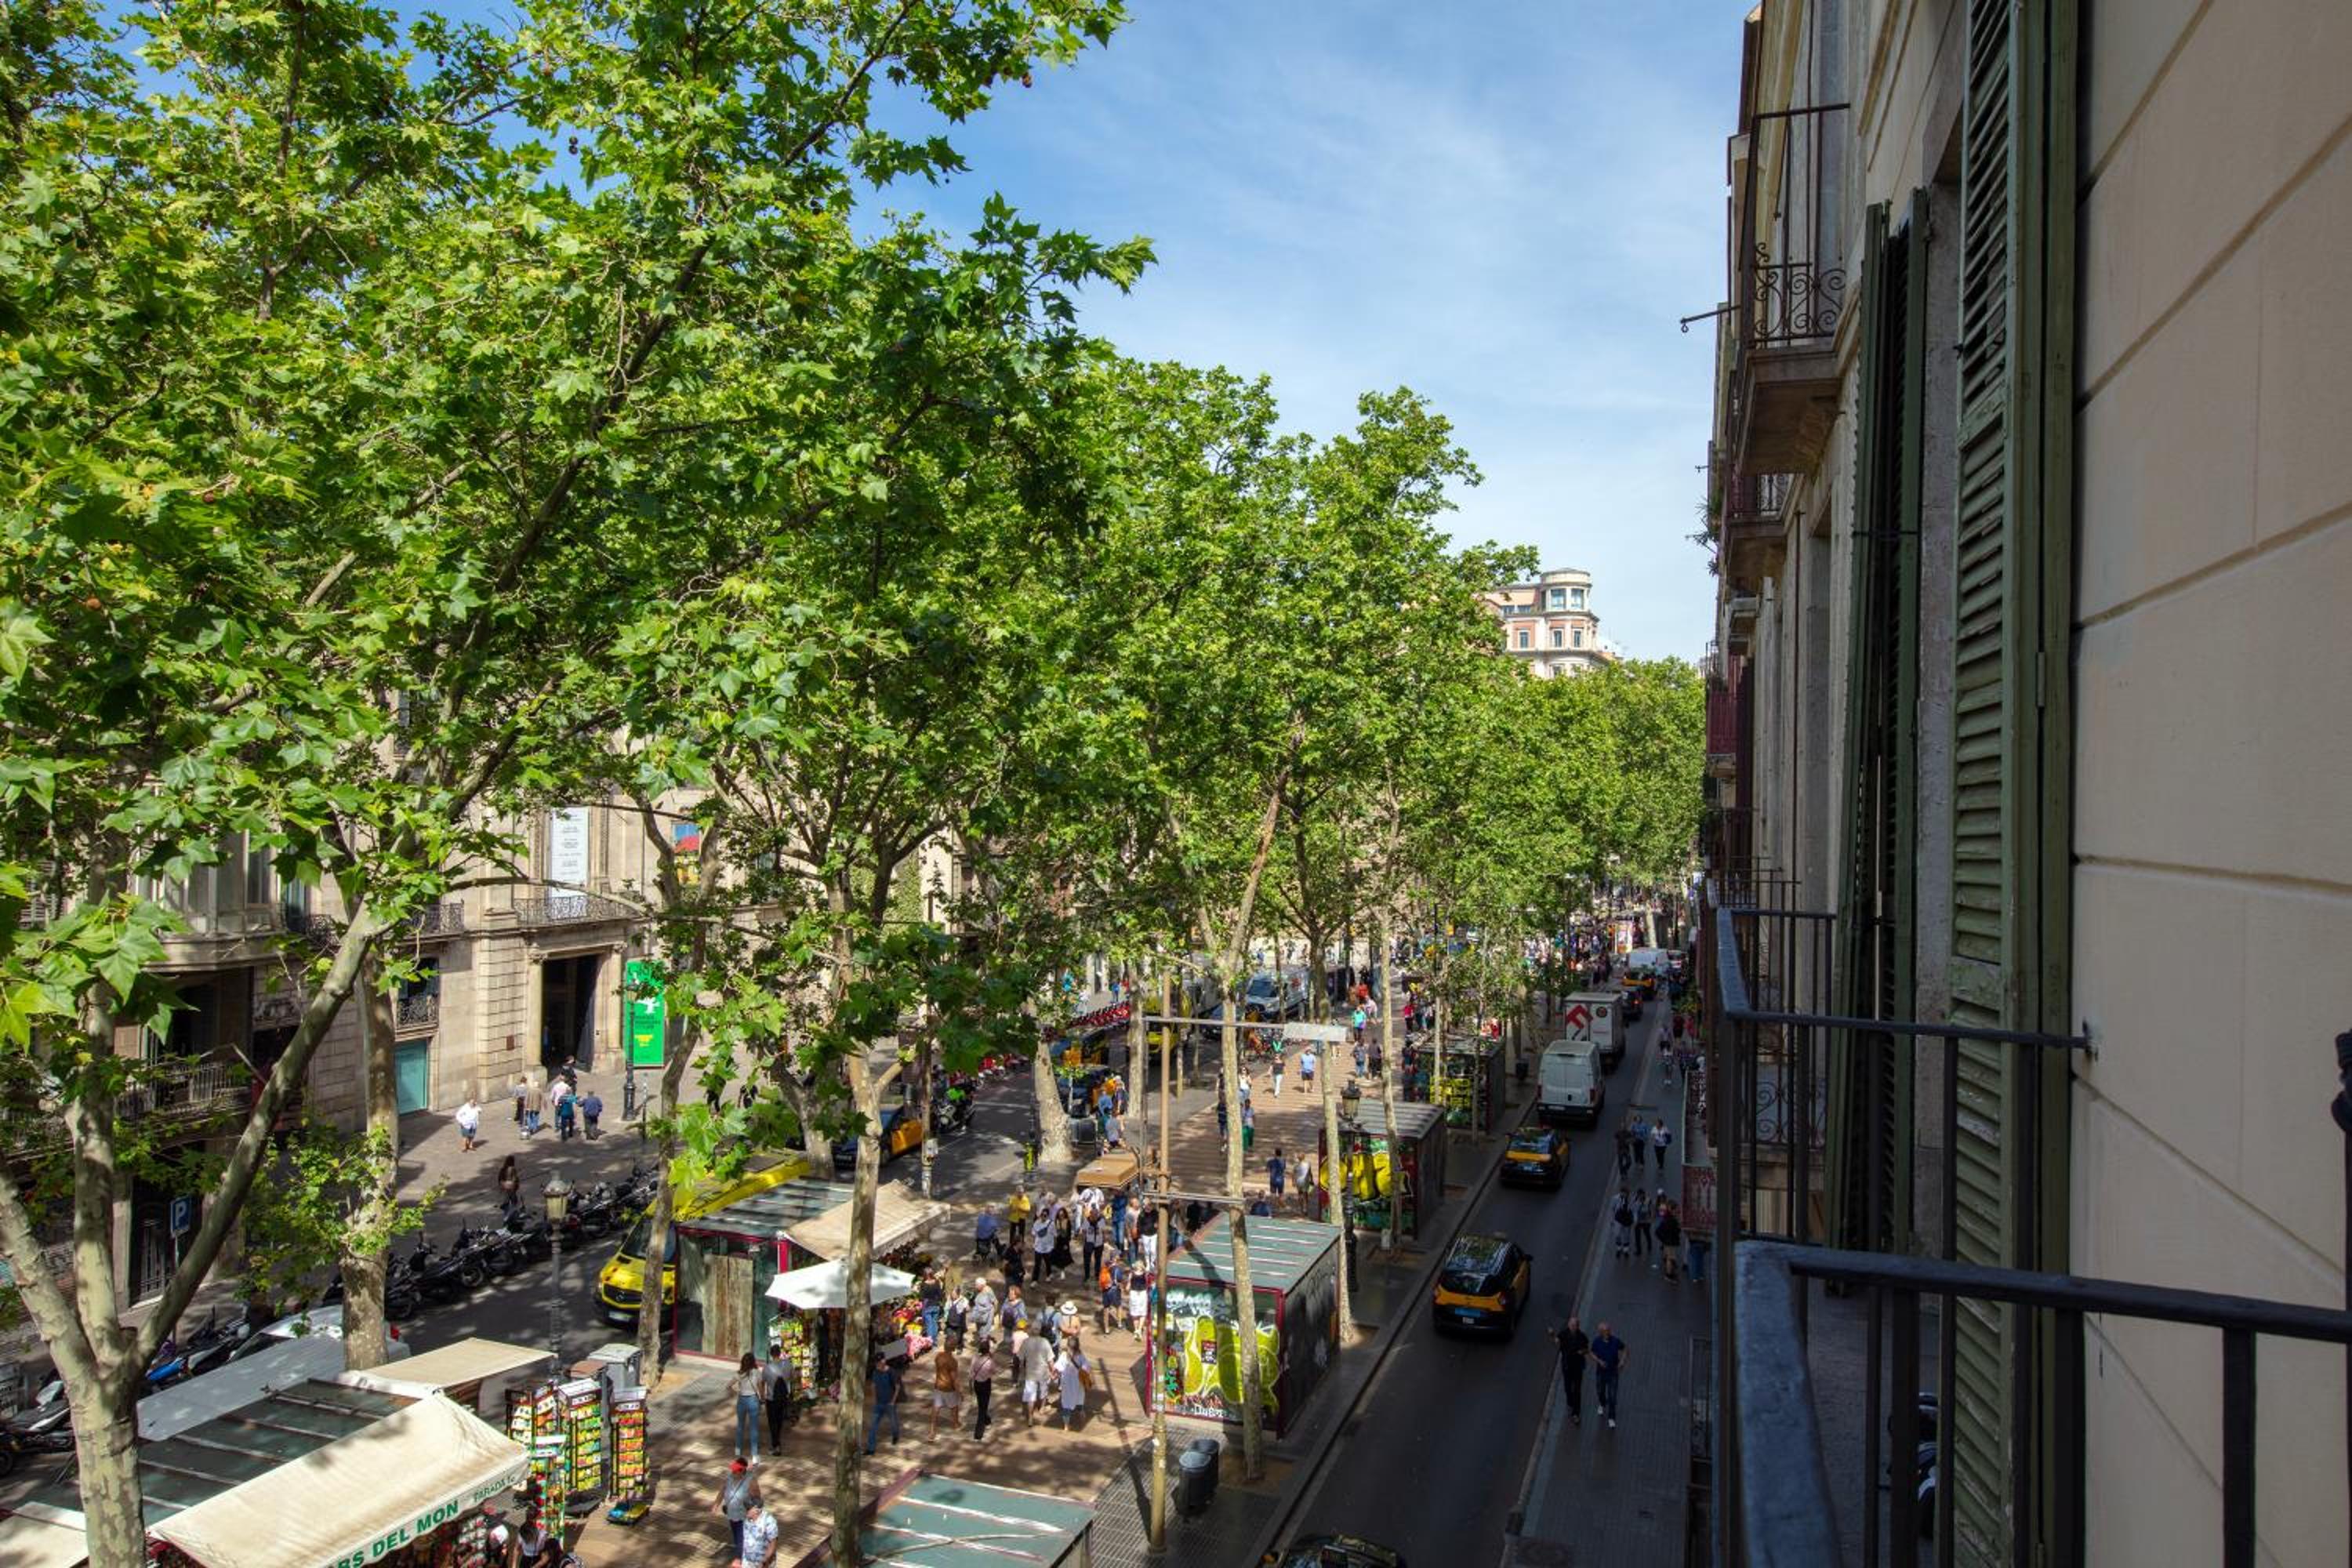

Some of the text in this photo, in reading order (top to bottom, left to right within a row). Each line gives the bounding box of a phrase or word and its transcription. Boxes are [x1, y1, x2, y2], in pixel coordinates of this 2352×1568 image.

[175, 1200, 187, 1228] P
[327, 1499, 459, 1568] RS DEL MON
